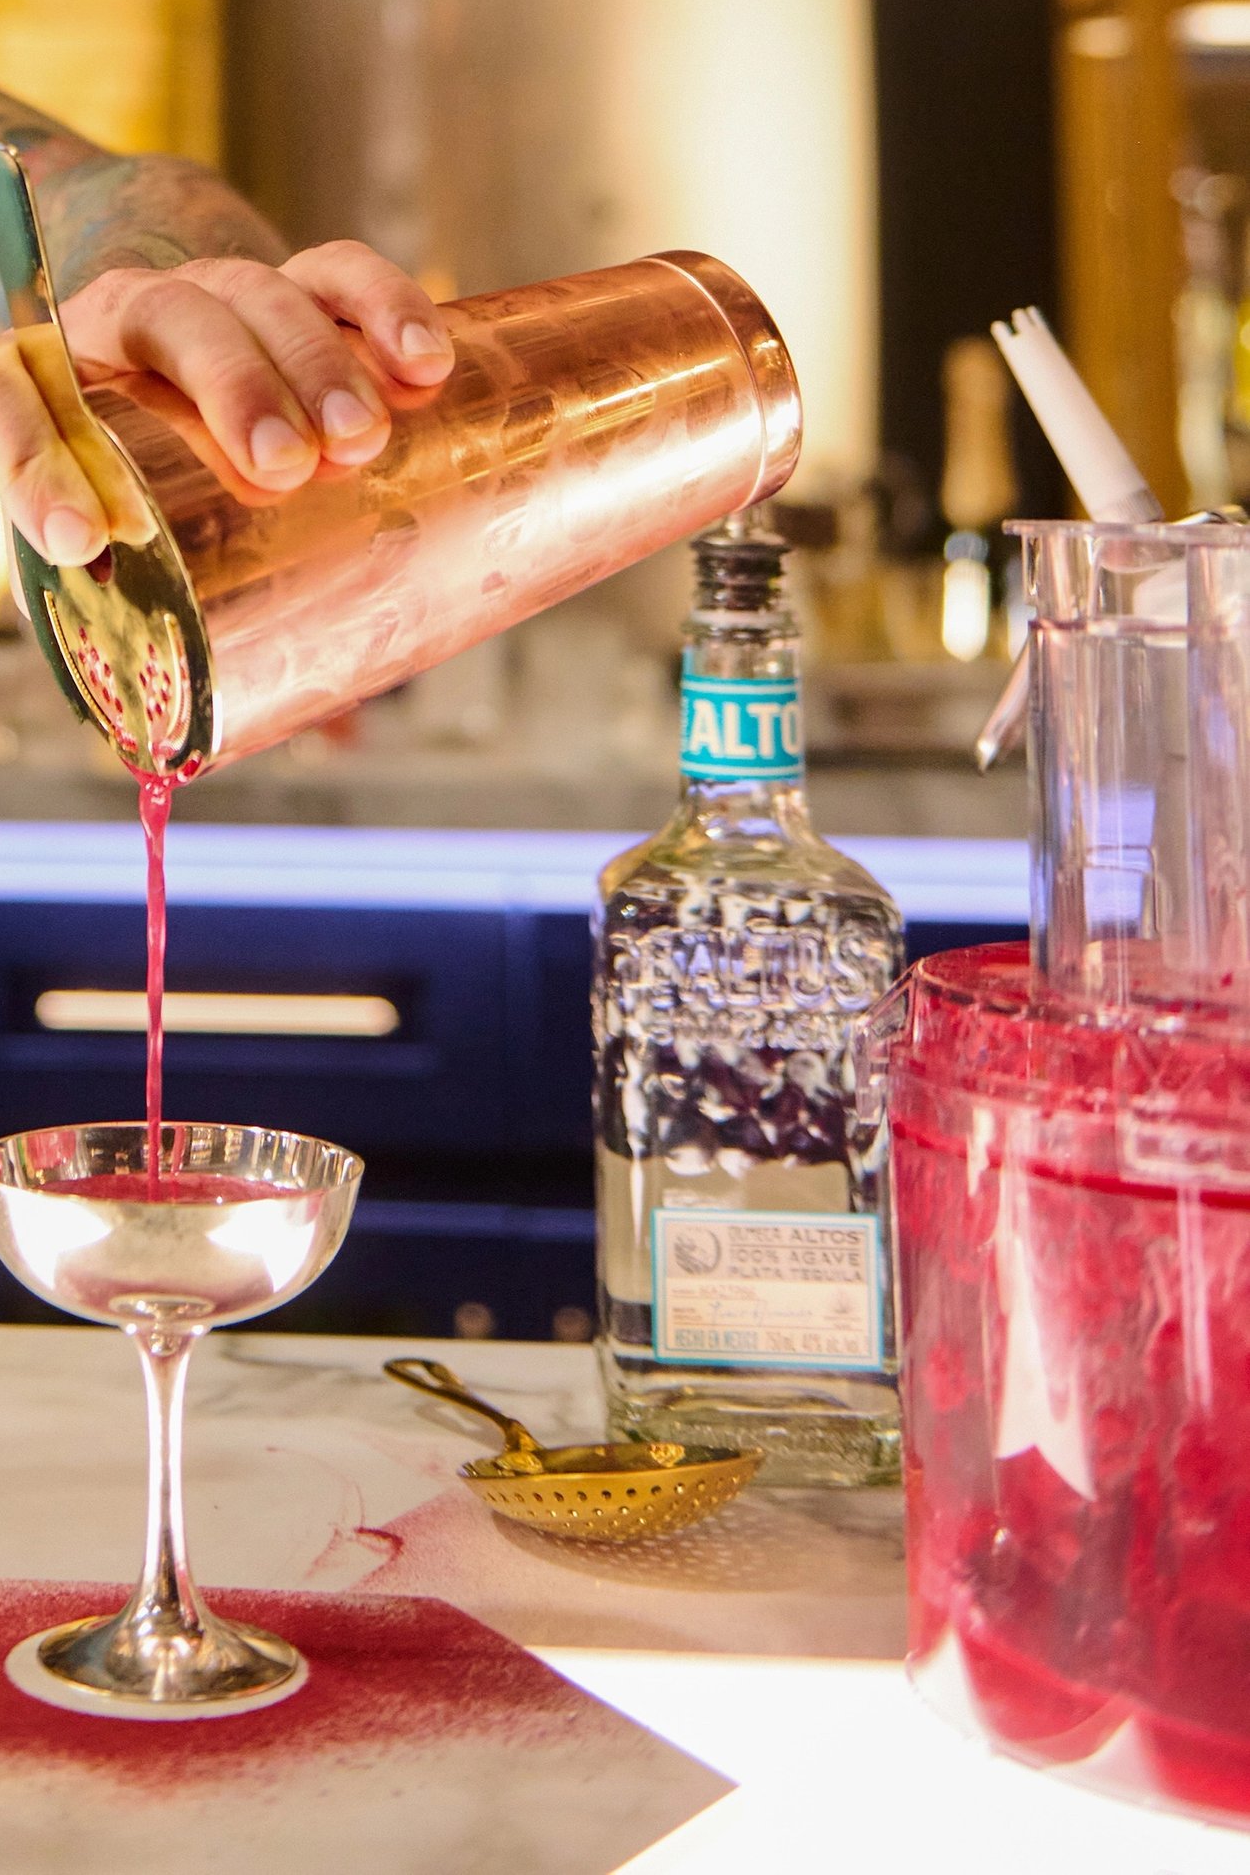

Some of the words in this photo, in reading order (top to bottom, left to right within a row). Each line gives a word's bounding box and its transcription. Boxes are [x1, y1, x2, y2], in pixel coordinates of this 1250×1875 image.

[789, 1228, 859, 1245] ALTOS
[728, 1249, 779, 1264] 100%
[788, 1251, 859, 1267] AGAVE
[727, 1266, 781, 1278] PLATA
[790, 1269, 861, 1282] TEQUILA
